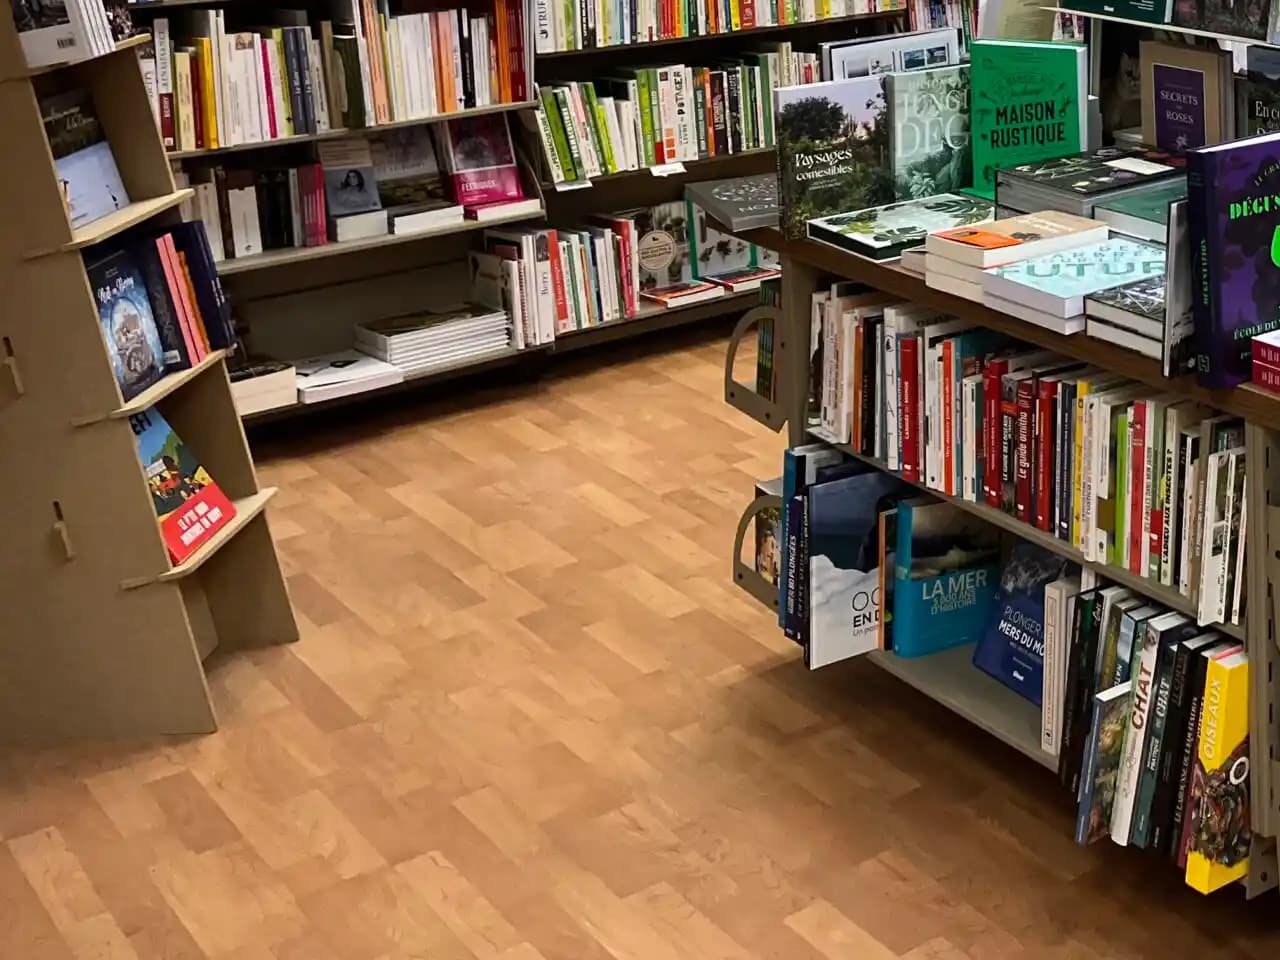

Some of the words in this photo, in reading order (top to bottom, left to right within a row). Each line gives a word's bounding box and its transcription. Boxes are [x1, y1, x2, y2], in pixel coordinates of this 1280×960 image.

[1160, 90, 1199, 106] SECRETS
[1255, 100, 1269, 117] En
[995, 100, 1056, 126] MAISON
[1166, 110, 1194, 125] ROSES
[990, 121, 1065, 149] RUSTIQUE
[794, 146, 853, 171] Paysages
[794, 163, 854, 182] comestibles
[1233, 324, 1263, 340] ÉCOLE
[1264, 320, 1278, 331] DU
[1019, 411, 1028, 442] ornitho
[1018, 442, 1030, 468] guide
[1018, 466, 1027, 479] Le
[1164, 459, 1173, 502] INSECTES
[922, 578, 944, 601] LA
[948, 569, 987, 593] MER
[853, 611, 872, 628] EN
[1004, 605, 1041, 636] PLONGER
[998, 620, 1021, 641] MERS
[1020, 632, 1034, 648] DU
[1132, 663, 1153, 730] CHAT
[1155, 678, 1170, 718] CHAT
[1204, 679, 1223, 760] OISEAUX
